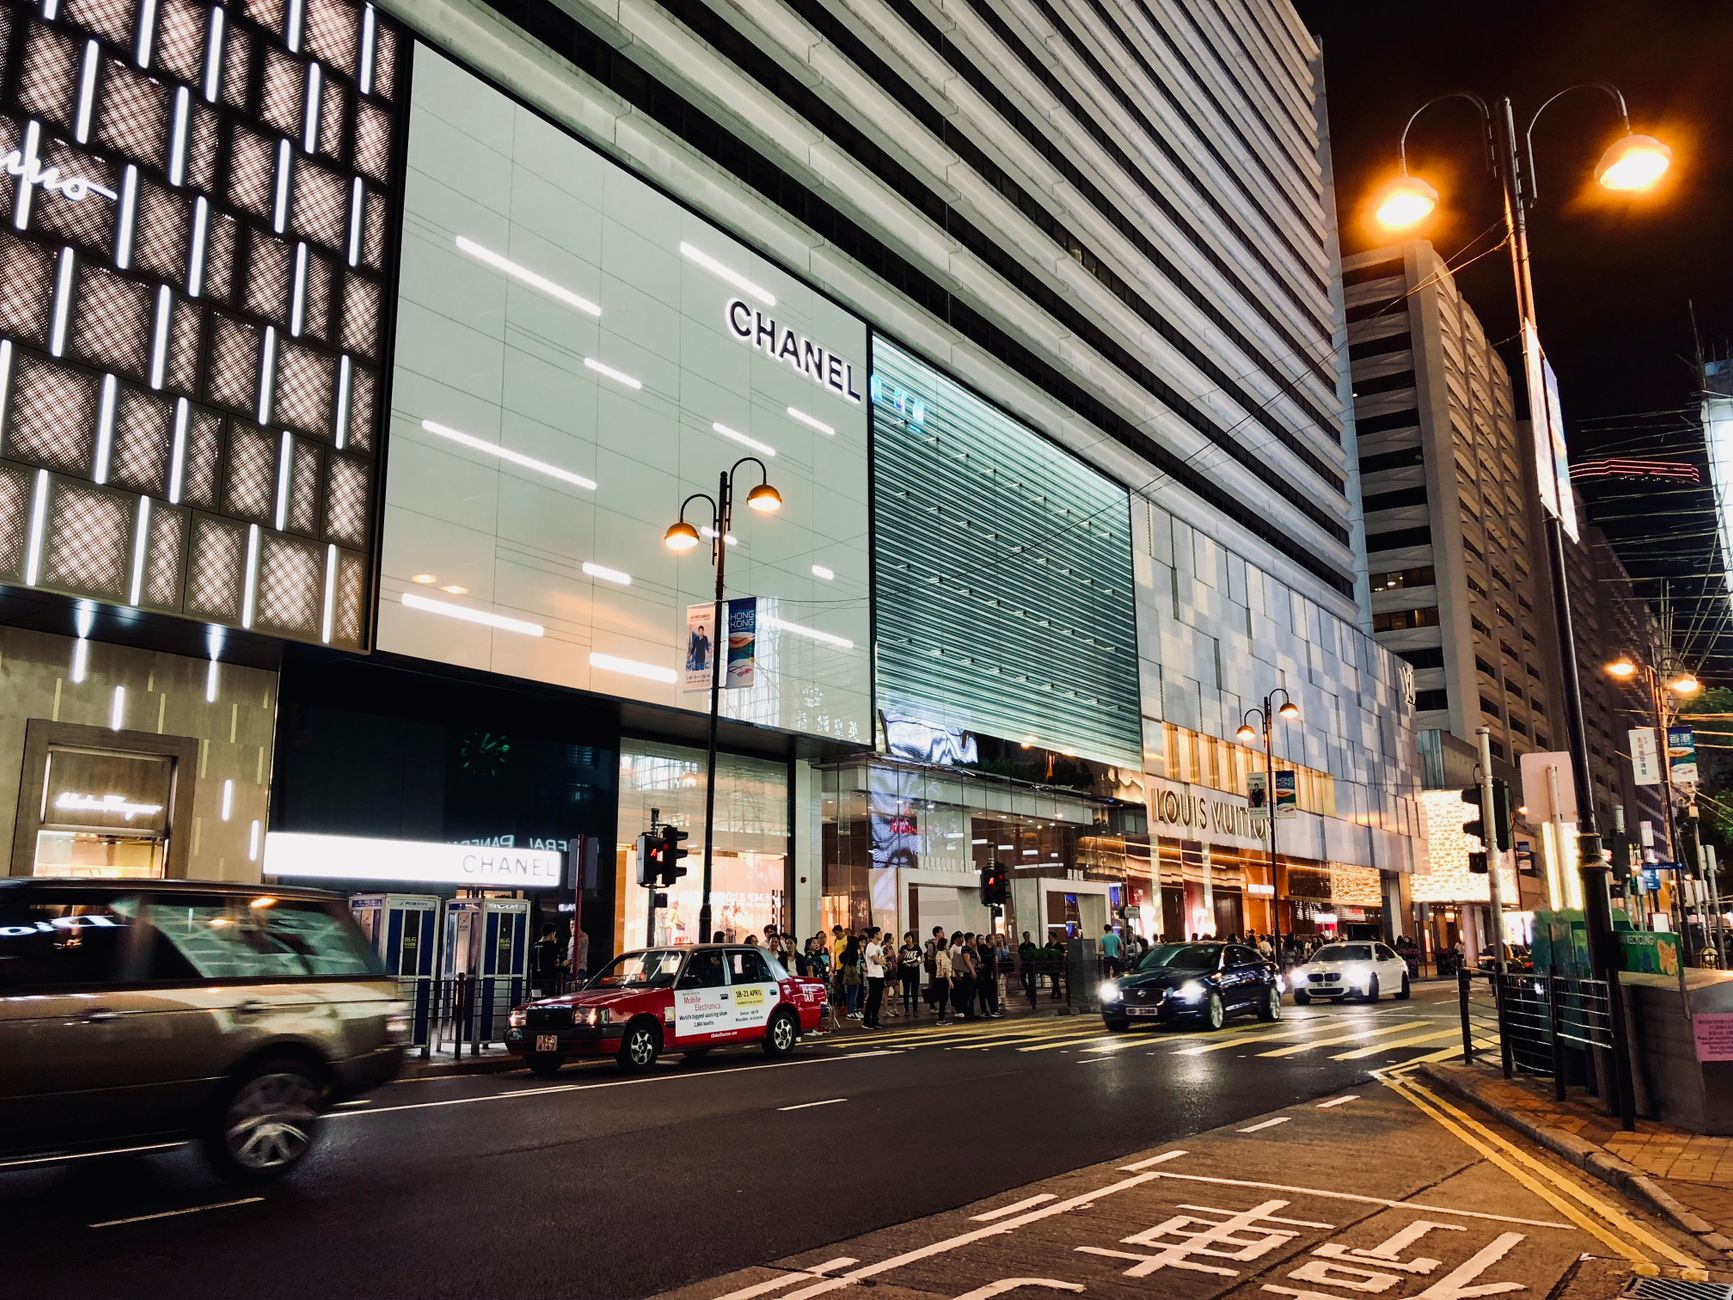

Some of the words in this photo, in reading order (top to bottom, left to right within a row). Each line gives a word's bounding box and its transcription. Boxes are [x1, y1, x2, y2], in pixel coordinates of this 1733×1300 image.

[729, 299, 861, 403] CHANEL
[730, 610, 755, 621] HONG
[730, 617, 755, 628] KONG
[1151, 787, 1207, 830] LOUIS
[462, 855, 556, 877] CHANEL
[736, 990, 749, 998] 18-21
[749, 989, 762, 997] APRIL
[683, 996, 701, 1005] Mobile
[694, 1002, 721, 1012] Electronics
[950, 1200, 1528, 1300] 停車
